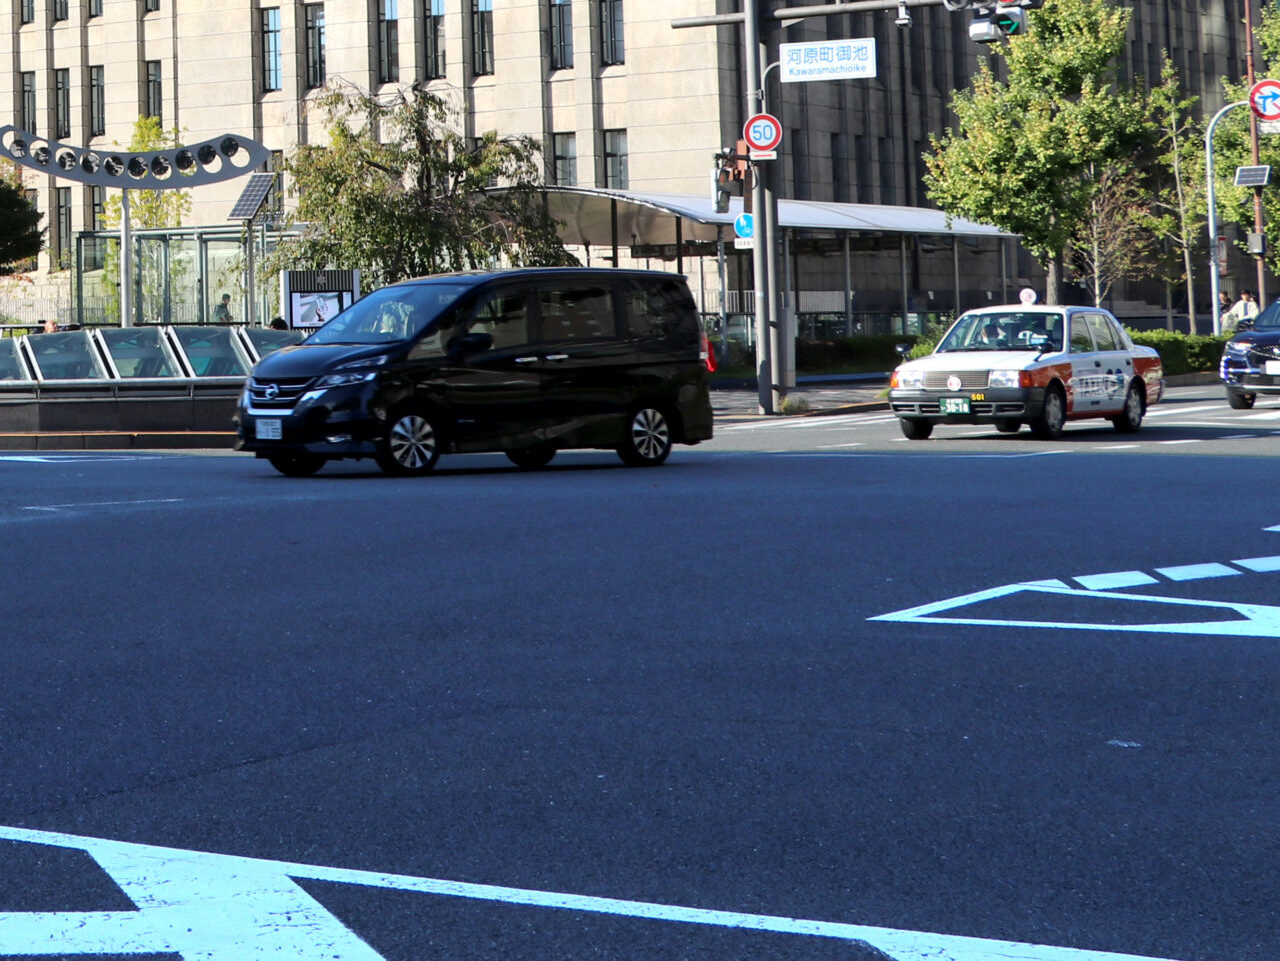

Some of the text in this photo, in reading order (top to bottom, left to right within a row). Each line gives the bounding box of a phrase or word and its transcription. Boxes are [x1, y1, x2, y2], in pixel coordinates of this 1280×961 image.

[787, 45, 869, 65] 河原町御池
[789, 64, 867, 77] Kawaramachioike
[752, 124, 773, 141] 50
